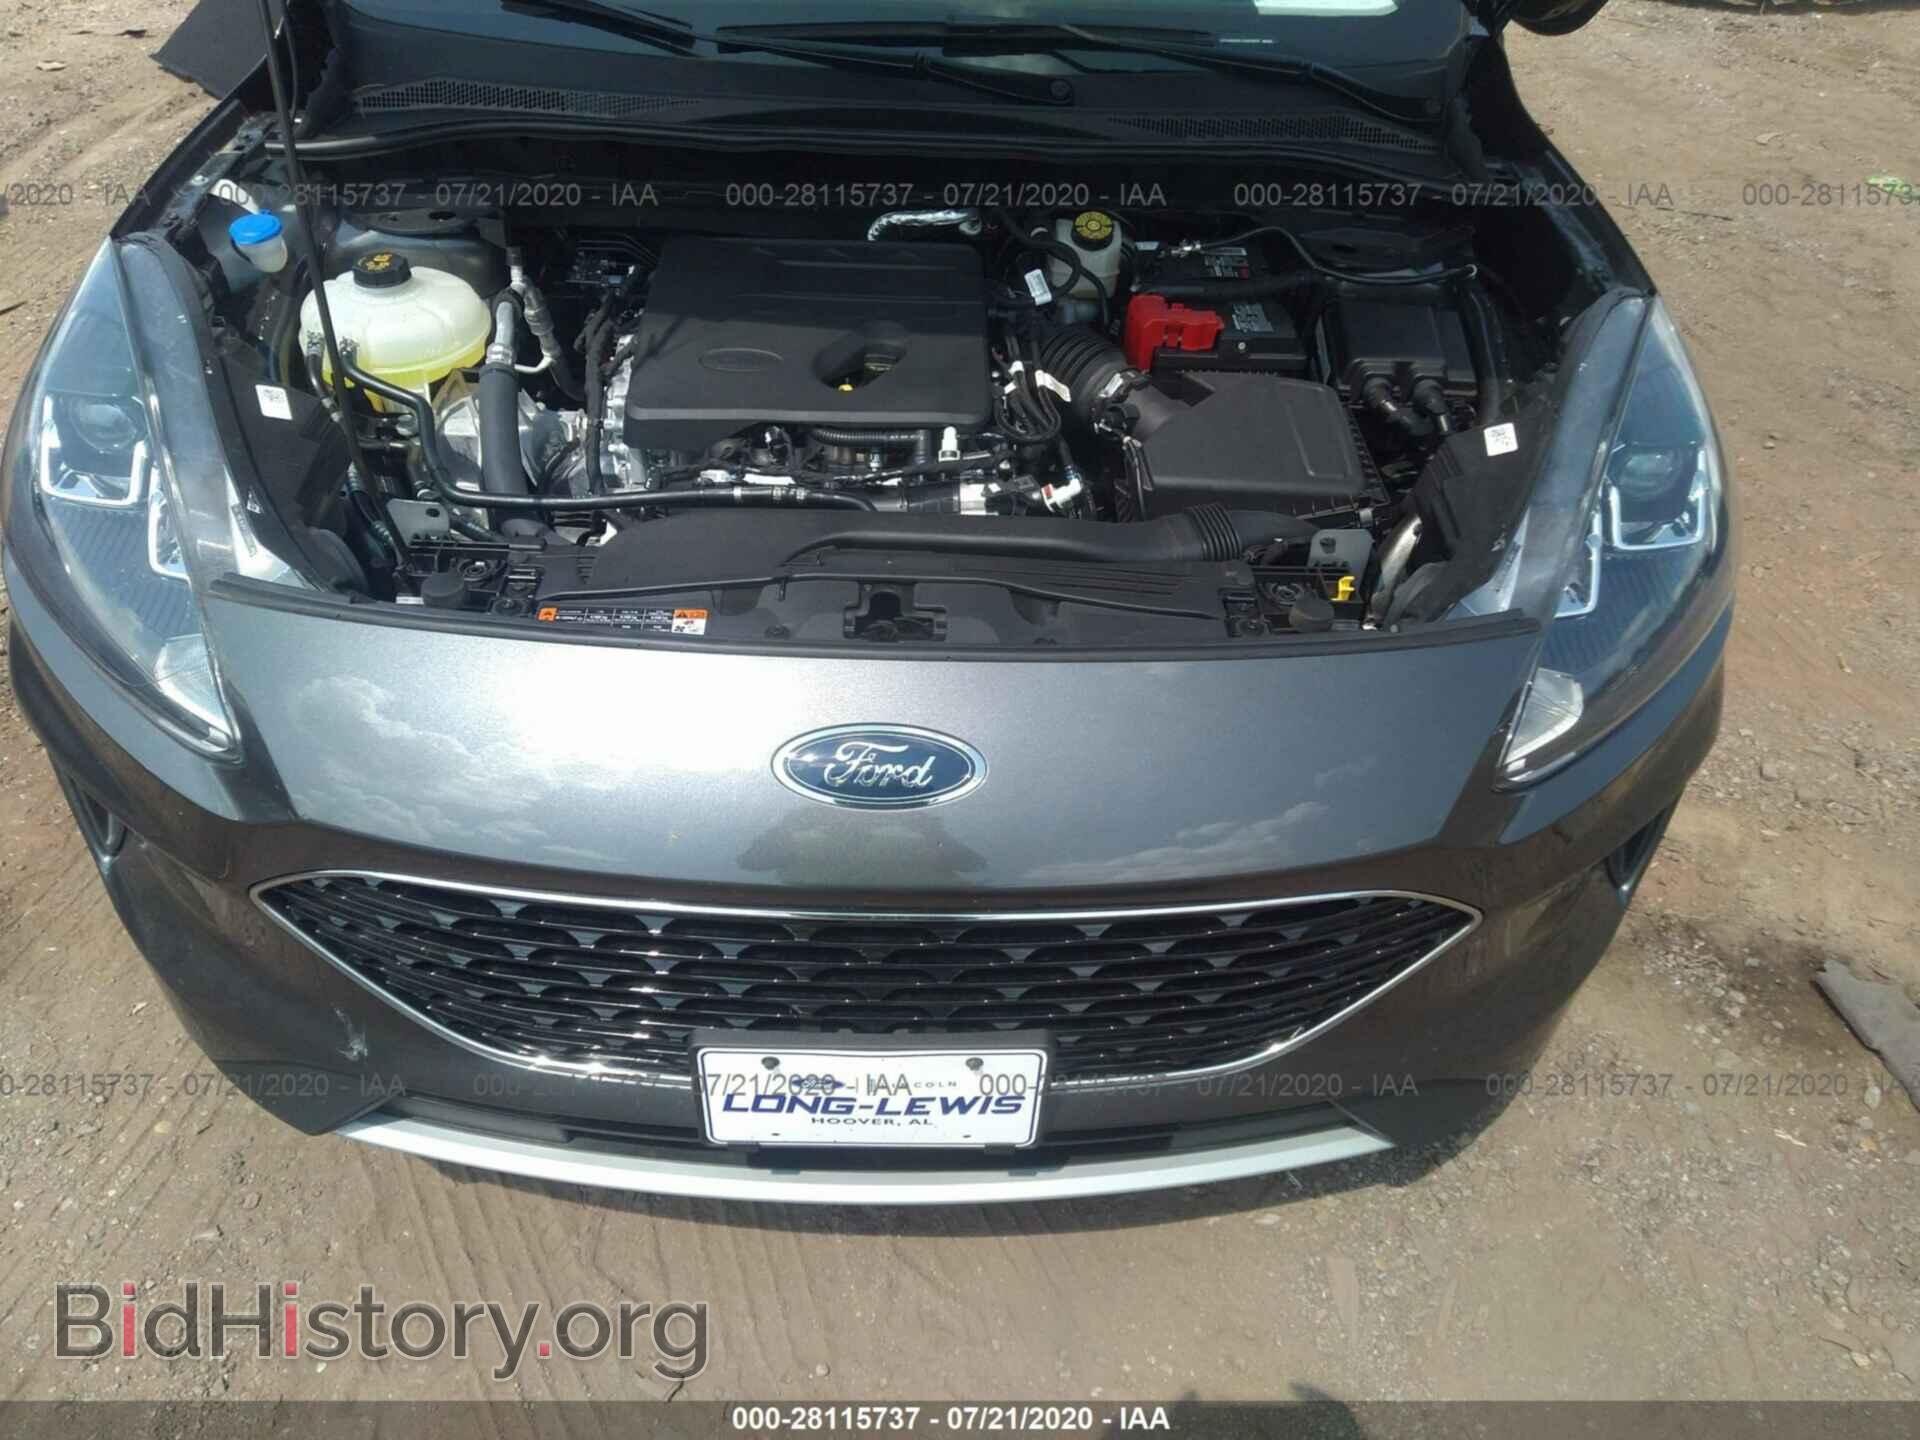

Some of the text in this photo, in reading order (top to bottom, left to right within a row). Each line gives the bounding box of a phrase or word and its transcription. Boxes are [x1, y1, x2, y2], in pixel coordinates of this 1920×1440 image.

[824, 741, 935, 788] Ford
[722, 1094, 1027, 1116] LONG-LEWIS
[811, 1116, 934, 1127] HOOVER, AL
